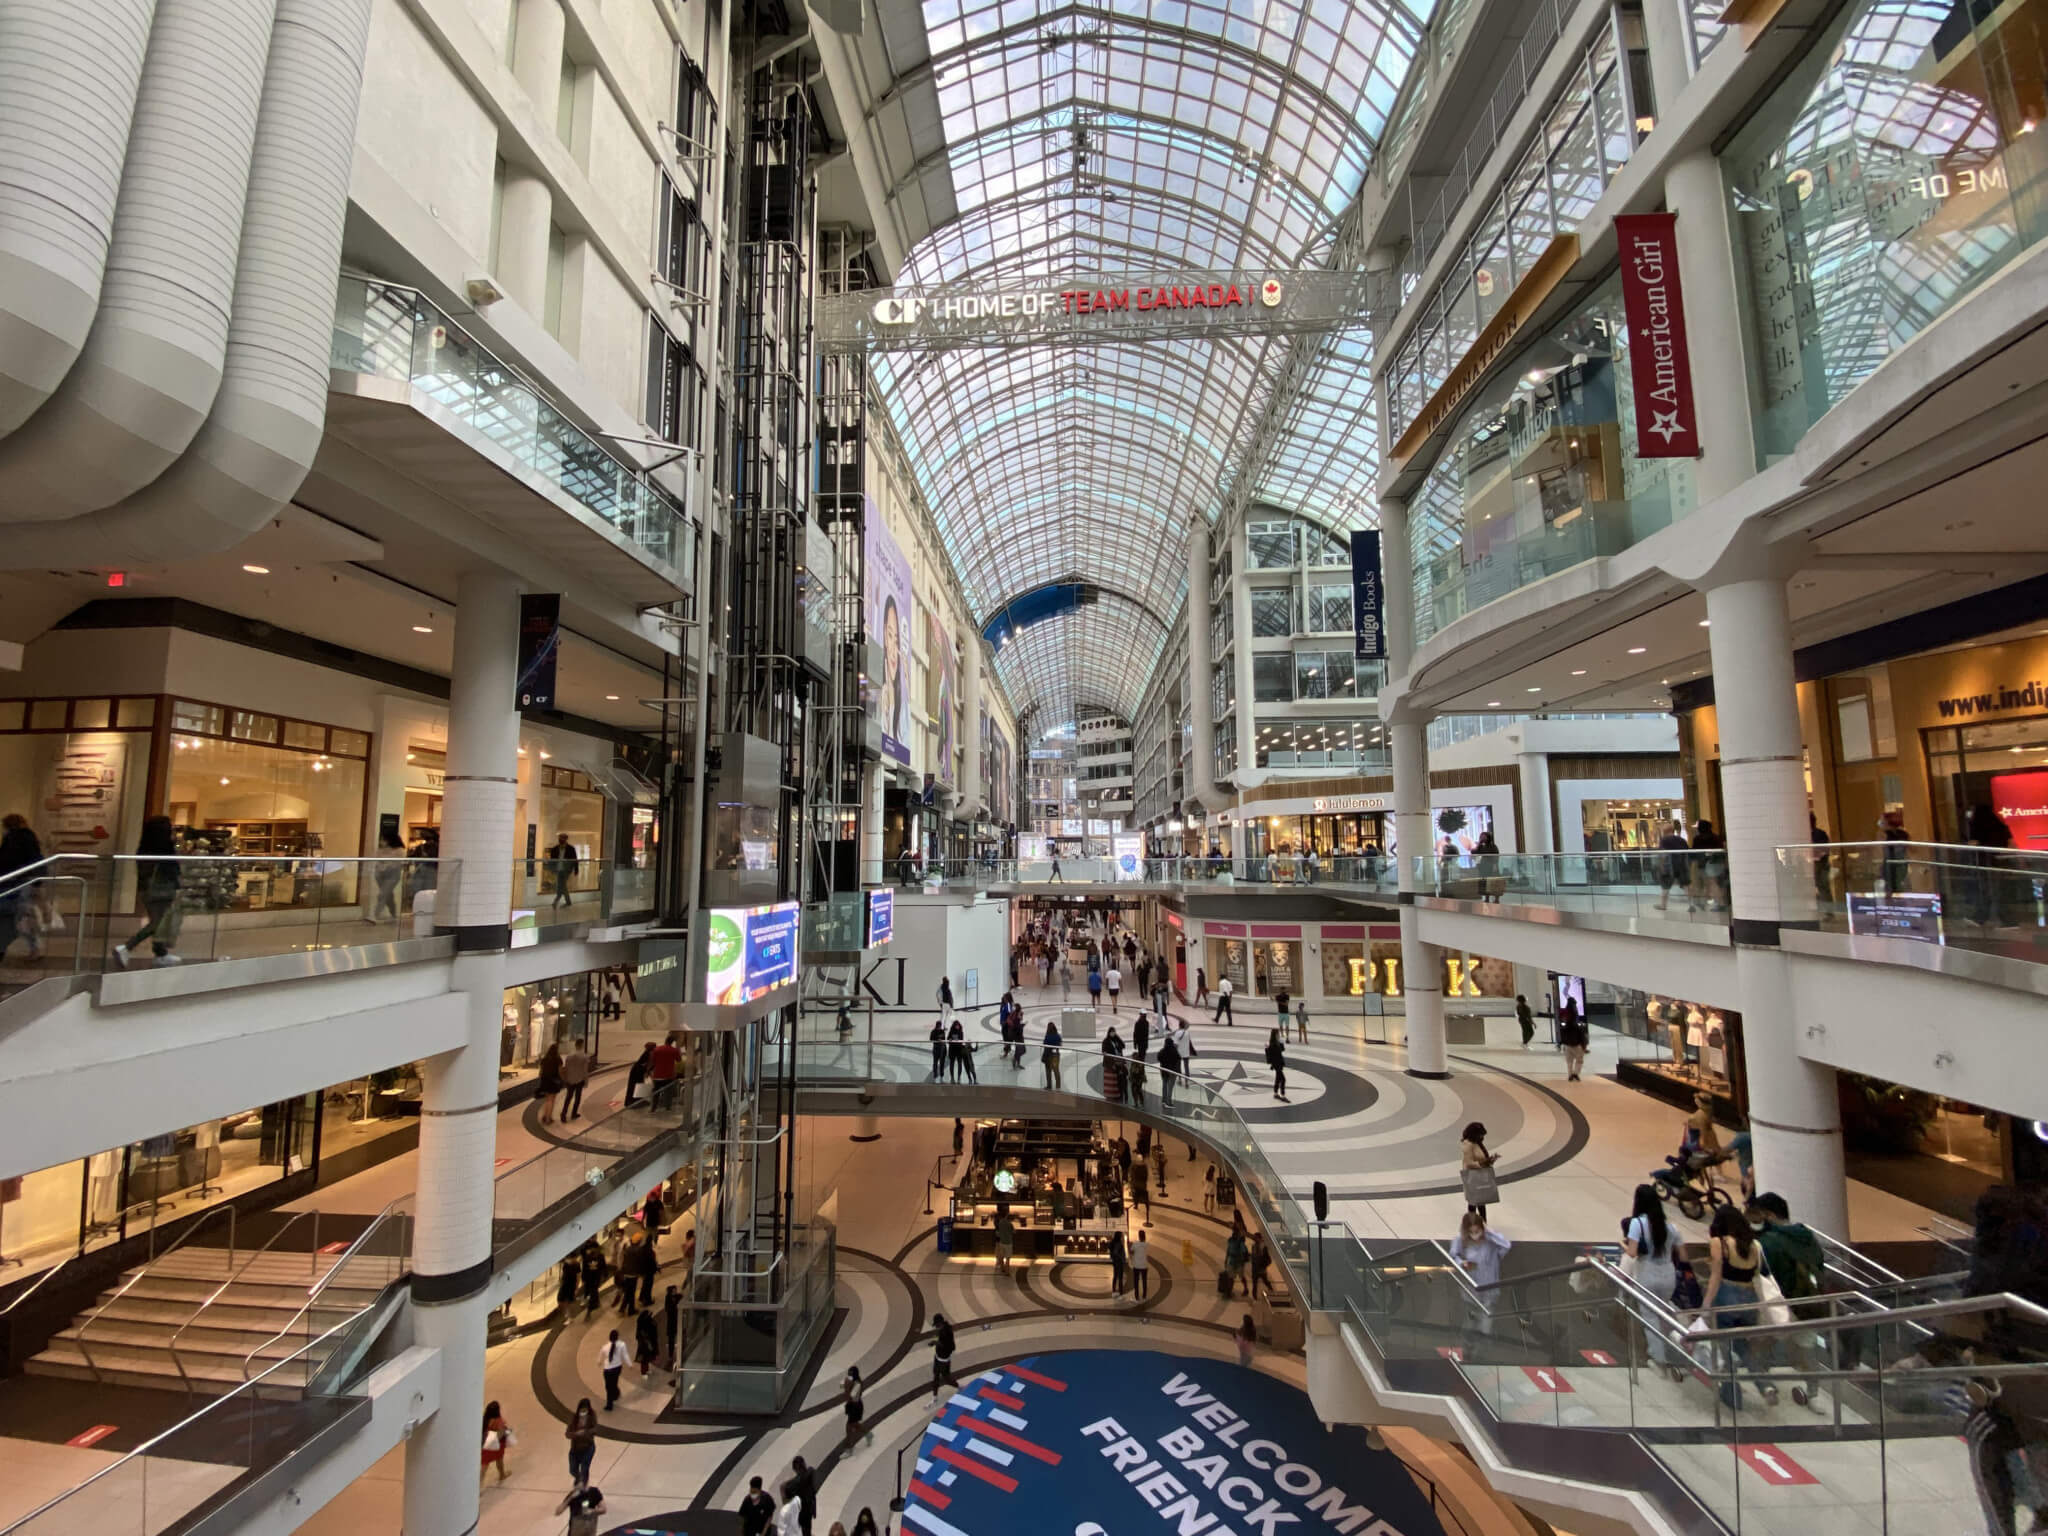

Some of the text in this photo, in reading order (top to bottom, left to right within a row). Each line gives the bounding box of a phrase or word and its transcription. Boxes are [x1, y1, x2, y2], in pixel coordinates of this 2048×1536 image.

[873, 284, 1242, 325] CF HOME OF TEAM CANADA
[1641, 286, 1677, 405] American
[1426, 313, 1518, 433] IMAGINATION
[1360, 570, 1380, 653] Indigo Books
[1329, 797, 1384, 809] lululemon
[1348, 957, 1482, 996] PIK
[1157, 1425, 1301, 1536] BACK
